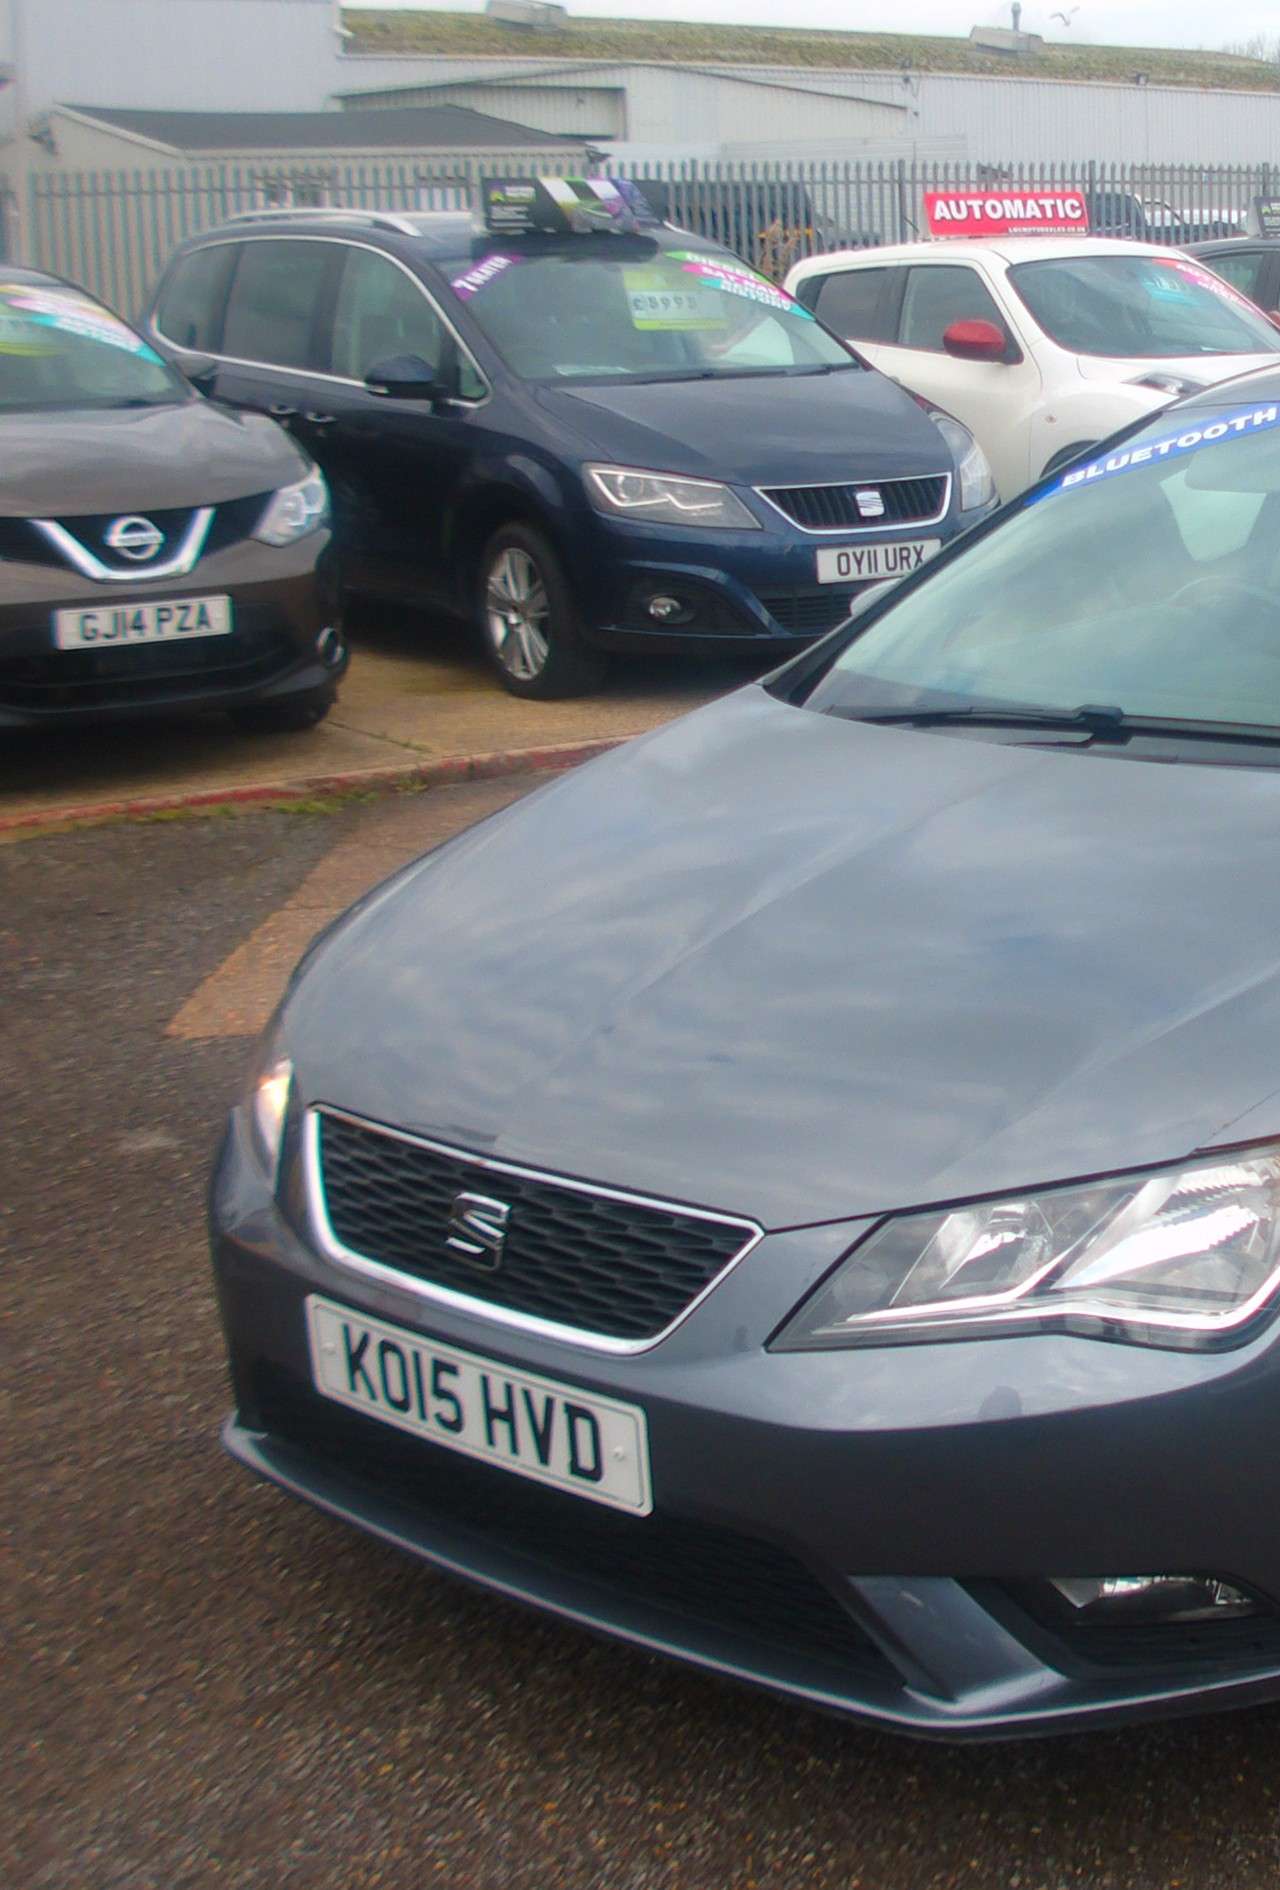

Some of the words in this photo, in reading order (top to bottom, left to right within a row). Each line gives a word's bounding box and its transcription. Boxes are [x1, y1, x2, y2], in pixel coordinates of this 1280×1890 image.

[934, 199, 1082, 220] AUTOMATIC
[1062, 407, 1277, 487] BLUETOOTH
[837, 550, 878, 576] OY11
[885, 545, 924, 572] URX
[79, 612, 146, 641] GJ14
[155, 604, 212, 634] PZA
[342, 1323, 464, 1433] KO15
[480, 1374, 604, 1482] HVD
